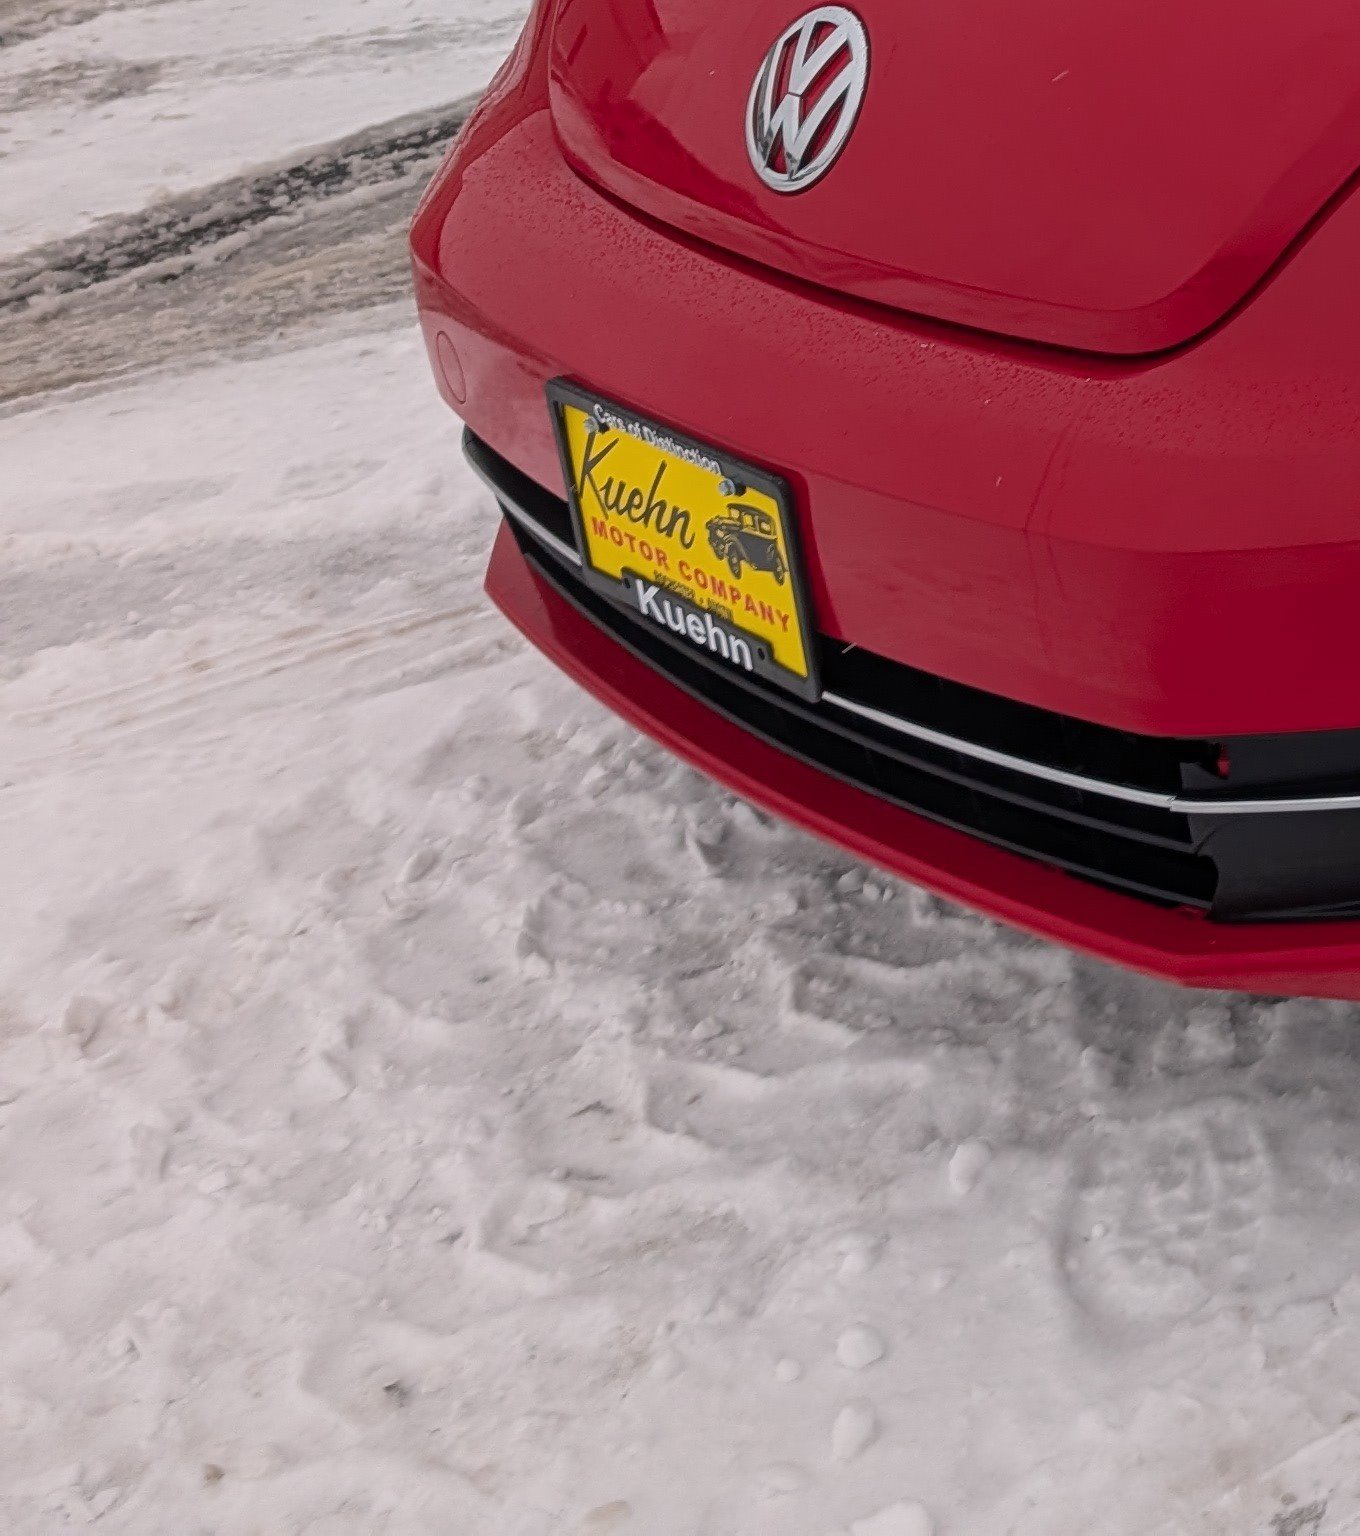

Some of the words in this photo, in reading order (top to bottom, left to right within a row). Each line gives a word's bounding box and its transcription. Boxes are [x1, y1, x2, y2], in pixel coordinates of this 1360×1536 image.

[578, 430, 696, 550] Kuehn
[642, 425, 722, 477] Distinction
[591, 516, 671, 572] MOTOR
[677, 559, 790, 633] COMPANY
[635, 577, 754, 671] Kuehn
